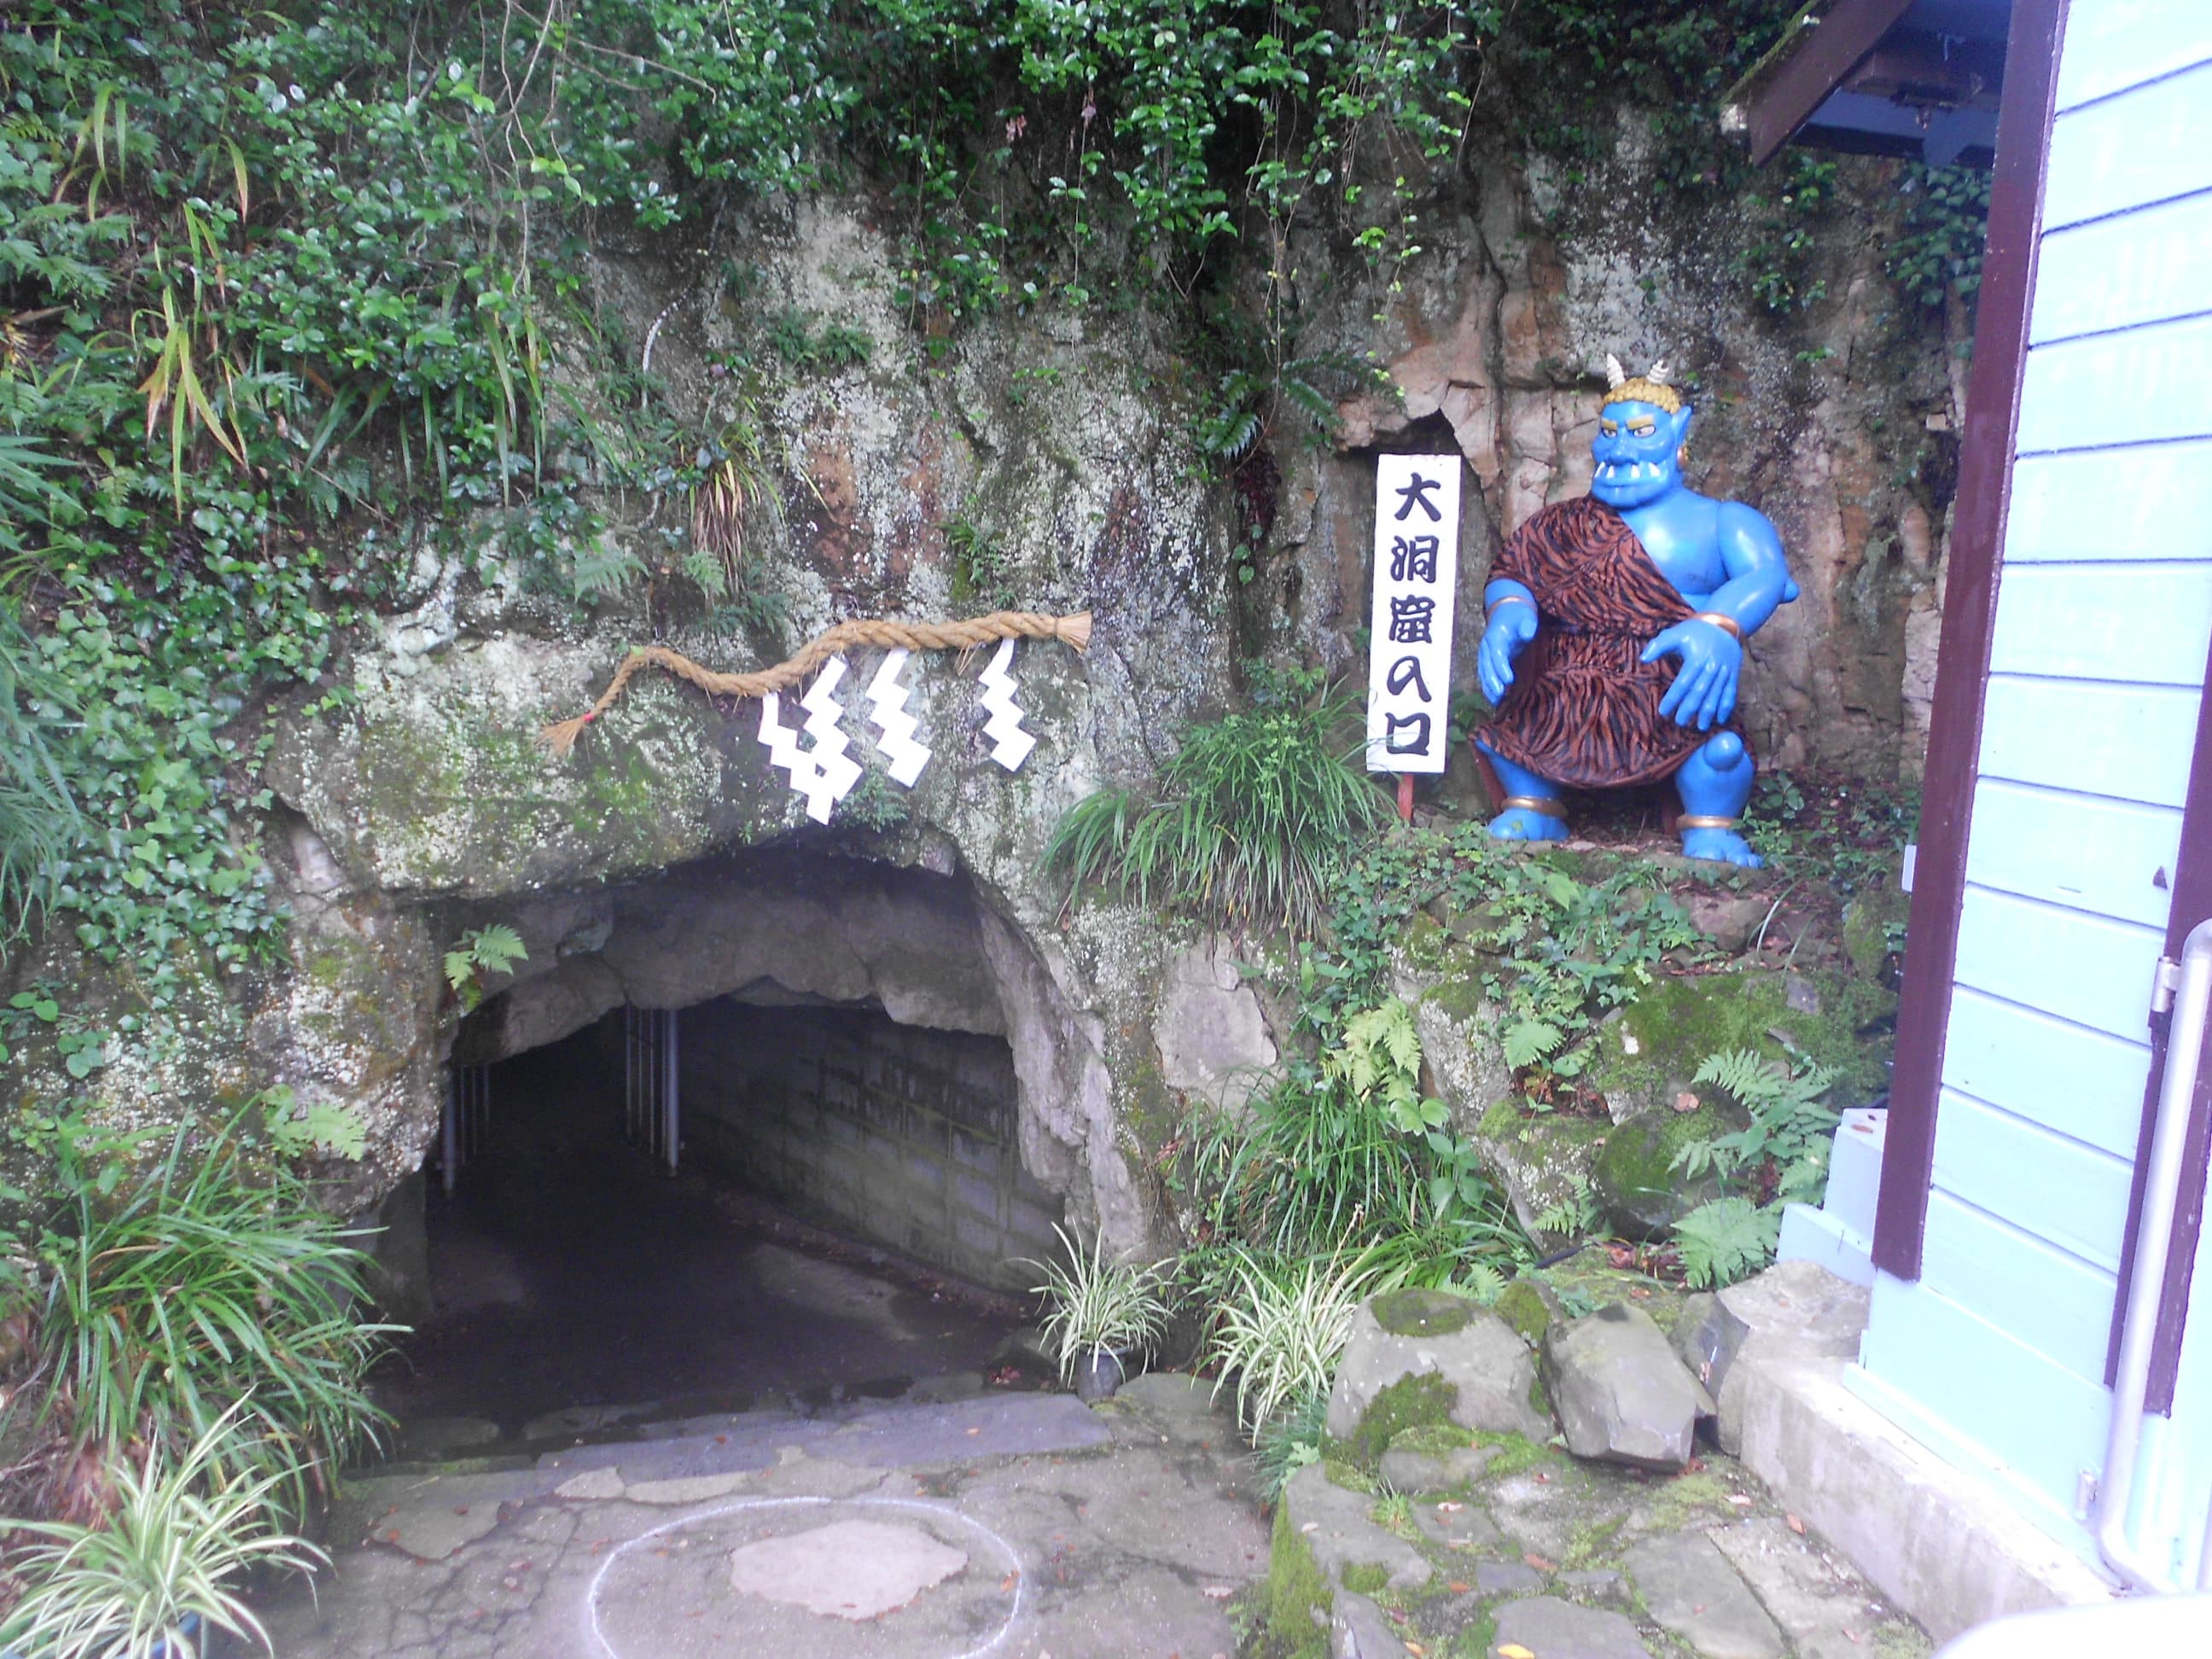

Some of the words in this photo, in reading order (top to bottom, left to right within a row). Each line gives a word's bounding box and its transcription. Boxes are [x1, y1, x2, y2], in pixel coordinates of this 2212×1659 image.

[1385, 472, 1442, 756] 大洞窟入口
